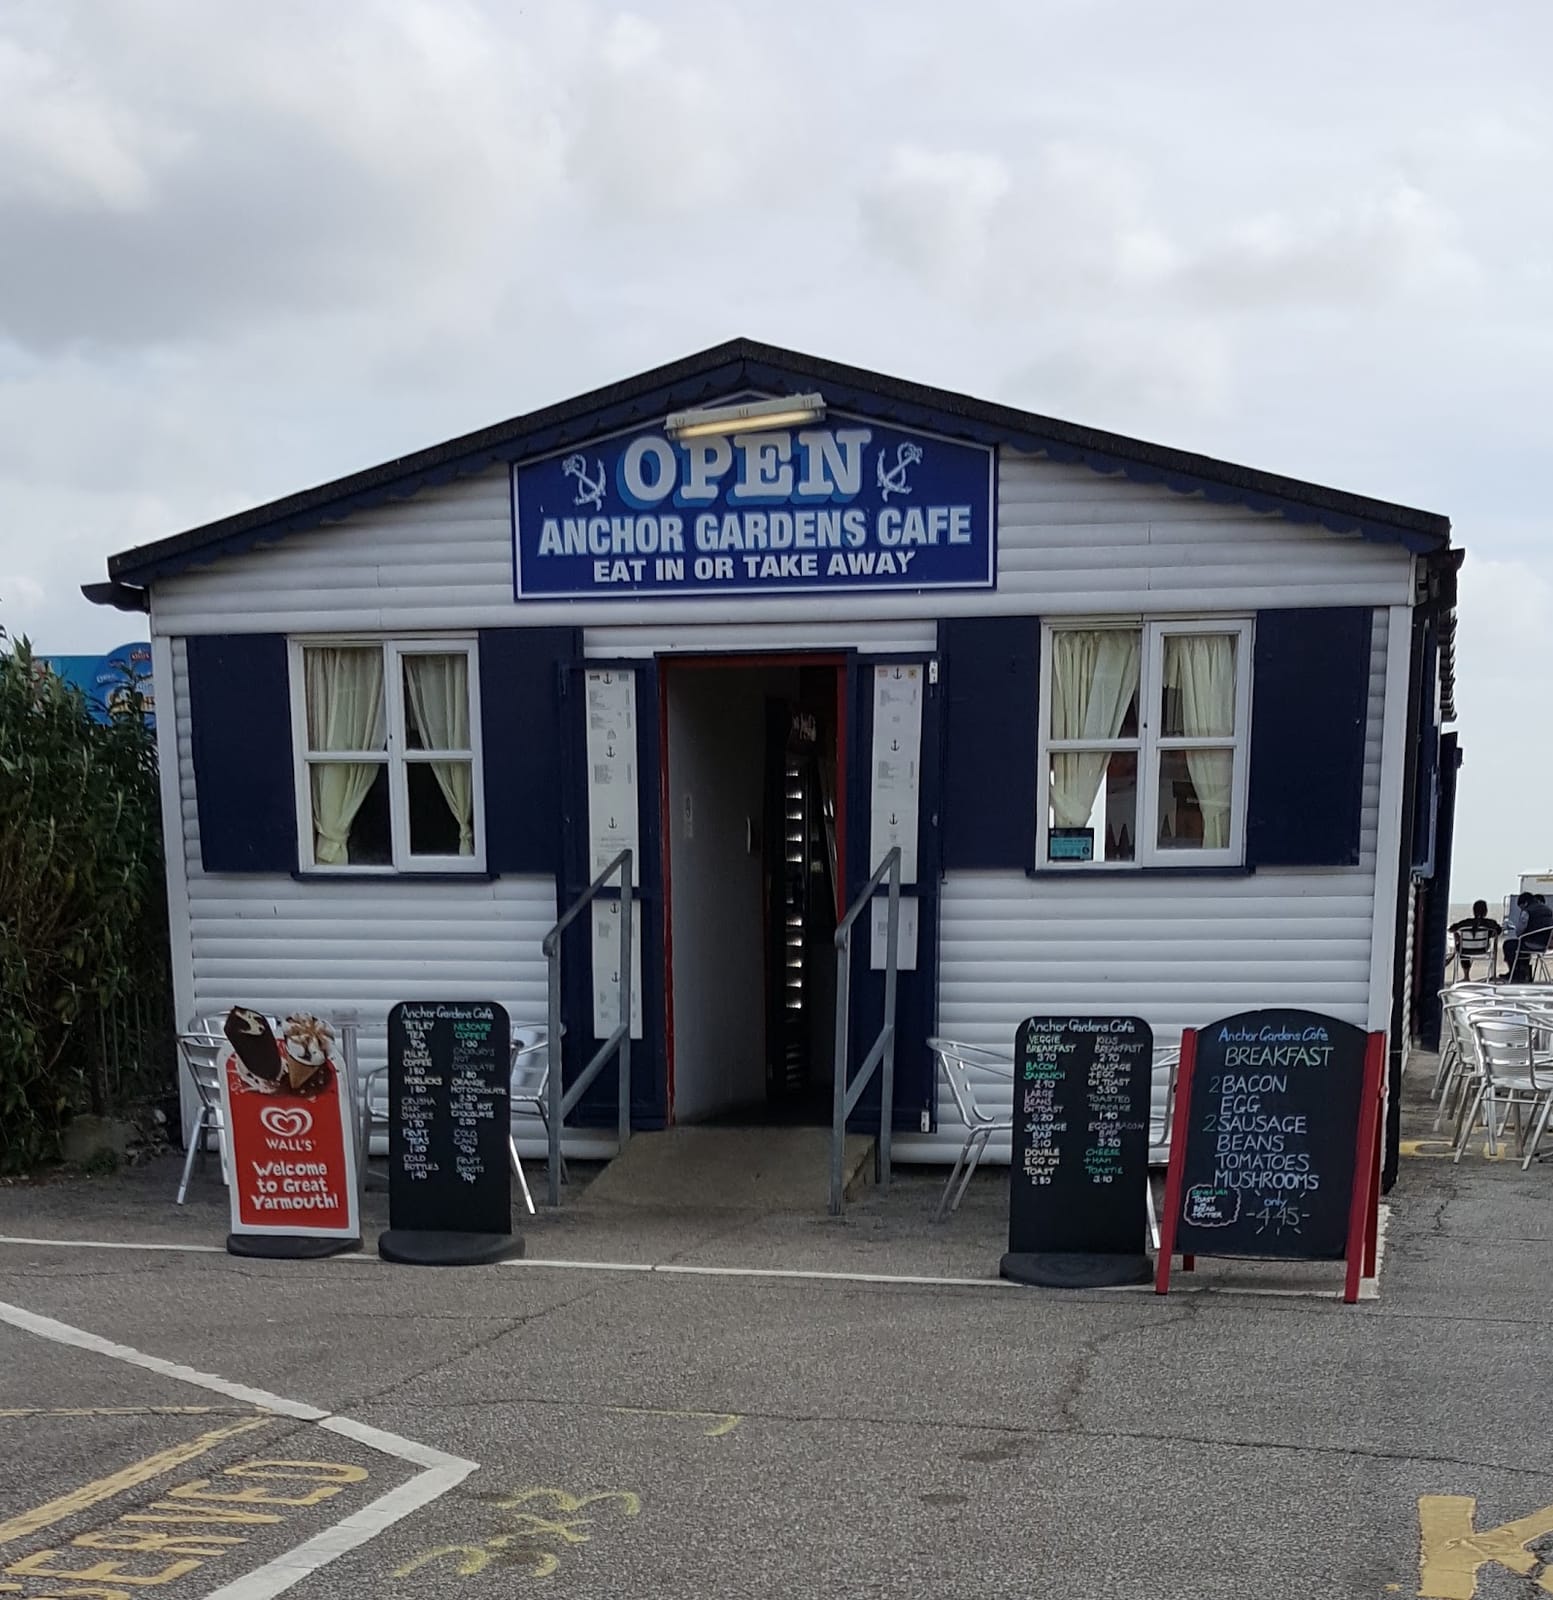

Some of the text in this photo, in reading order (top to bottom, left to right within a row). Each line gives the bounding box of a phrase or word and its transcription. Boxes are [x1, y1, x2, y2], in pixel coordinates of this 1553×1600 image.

[621, 429, 872, 503] OPEN
[537, 504, 973, 556] ANCHOR GARDENS CAFE
[593, 551, 917, 583] EAT IN OR TAKE AWAY
[1026, 1018, 1068, 1032] Anchor
[1068, 1019, 1109, 1033] Gardens
[407, 1031, 426, 1040] TEA
[1218, 1027, 1259, 1042] Anchor
[1259, 1026, 1301, 1041] Gardens
[1029, 1035, 1062, 1044] VEGGIE
[1096, 1036, 1119, 1044] KIDS
[1026, 1044, 1077, 1053] BREAKFAST
[1094, 1044, 1145, 1054] BREAKFAST
[403, 1050, 430, 1060] MILKY
[1224, 1046, 1334, 1067] BREAKFAST
[403, 1059, 432, 1067] COFFEE
[1026, 1062, 1058, 1072] BACON
[1090, 1063, 1132, 1072] SAUSAGE
[1023, 1071, 1065, 1080] SANDWICH
[1101, 1078, 1130, 1087] TOAST
[1209, 1074, 1288, 1094] 2 BACON
[1024, 1089, 1055, 1098] LARGE
[1024, 1097, 1052, 1106] BEANS
[1087, 1094, 1131, 1104] TOASTED
[476, 1102, 494, 1110] HOT
[1088, 1103, 1131, 1112] TEACAKE
[1220, 1094, 1261, 1115] EGG
[1023, 1105, 1064, 1114] ON TOAST
[1024, 1123, 1067, 1132] SAUSAGE
[1202, 1114, 1307, 1134] 2 SAUSAGE
[403, 1129, 430, 1139] FRUIT
[454, 1129, 477, 1138] COLD
[1033, 1131, 1052, 1139] BAP
[1099, 1130, 1118, 1138] BAP
[266, 1138, 313, 1151] WALL'S
[408, 1137, 430, 1146] TEAS
[453, 1137, 478, 1146] CANS
[1216, 1134, 1285, 1152] BEANS
[1024, 1148, 1060, 1156] DOUBLE
[1085, 1148, 1120, 1156] CHEESE
[403, 1154, 426, 1162] COLD
[456, 1156, 482, 1165] FRUIT
[1025, 1156, 1060, 1165] EGG ON
[1214, 1153, 1310, 1172] TOMATOES
[252, 1161, 327, 1176] Welcome
[404, 1162, 440, 1171] BOTTLES
[1023, 1166, 1055, 1175] TOAST
[1085, 1166, 1124, 1175] TOASTIE
[1214, 1170, 1320, 1190] MUSHROOMS
[257, 1177, 328, 1193] to Great
[251, 1193, 339, 1210] Yarmouth!
[1264, 1194, 1288, 1209] only
